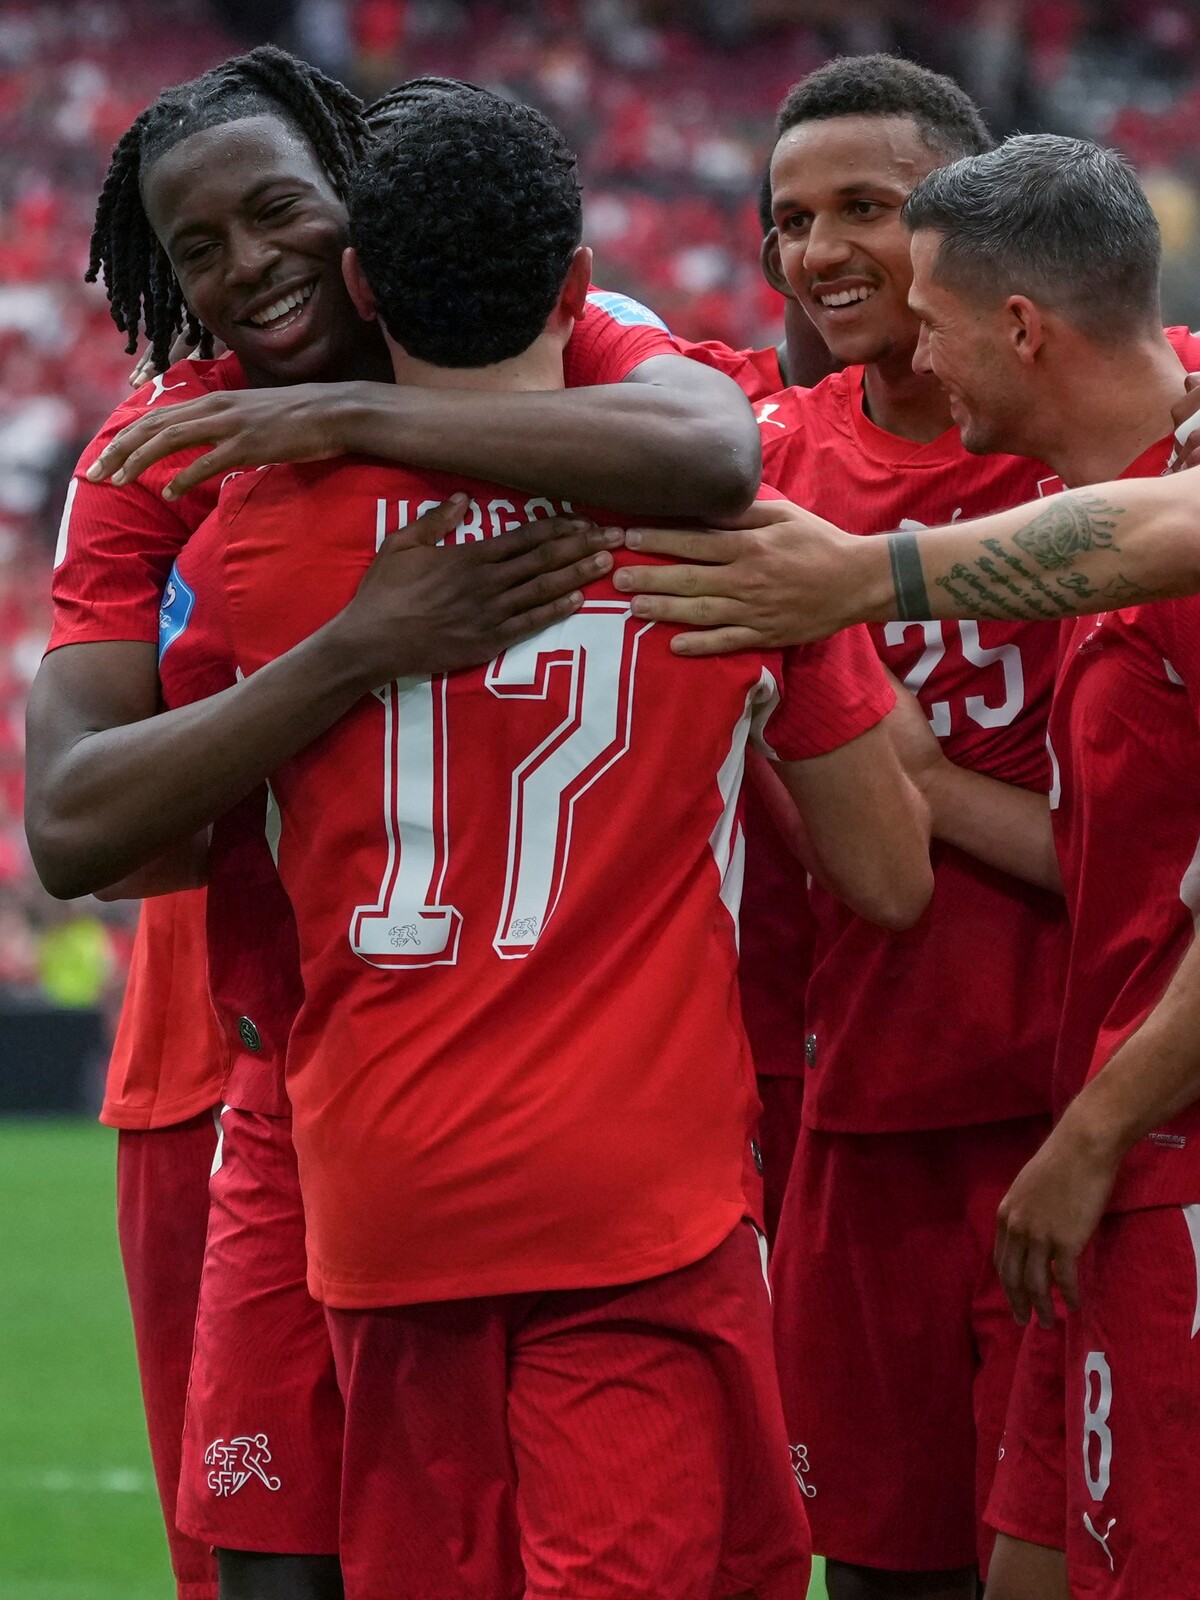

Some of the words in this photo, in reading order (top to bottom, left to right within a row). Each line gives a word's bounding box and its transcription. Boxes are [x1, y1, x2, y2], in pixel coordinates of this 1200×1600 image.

[884, 619, 1024, 737] 25
[349, 600, 657, 969] 17
[1083, 1352, 1113, 1501] 8
